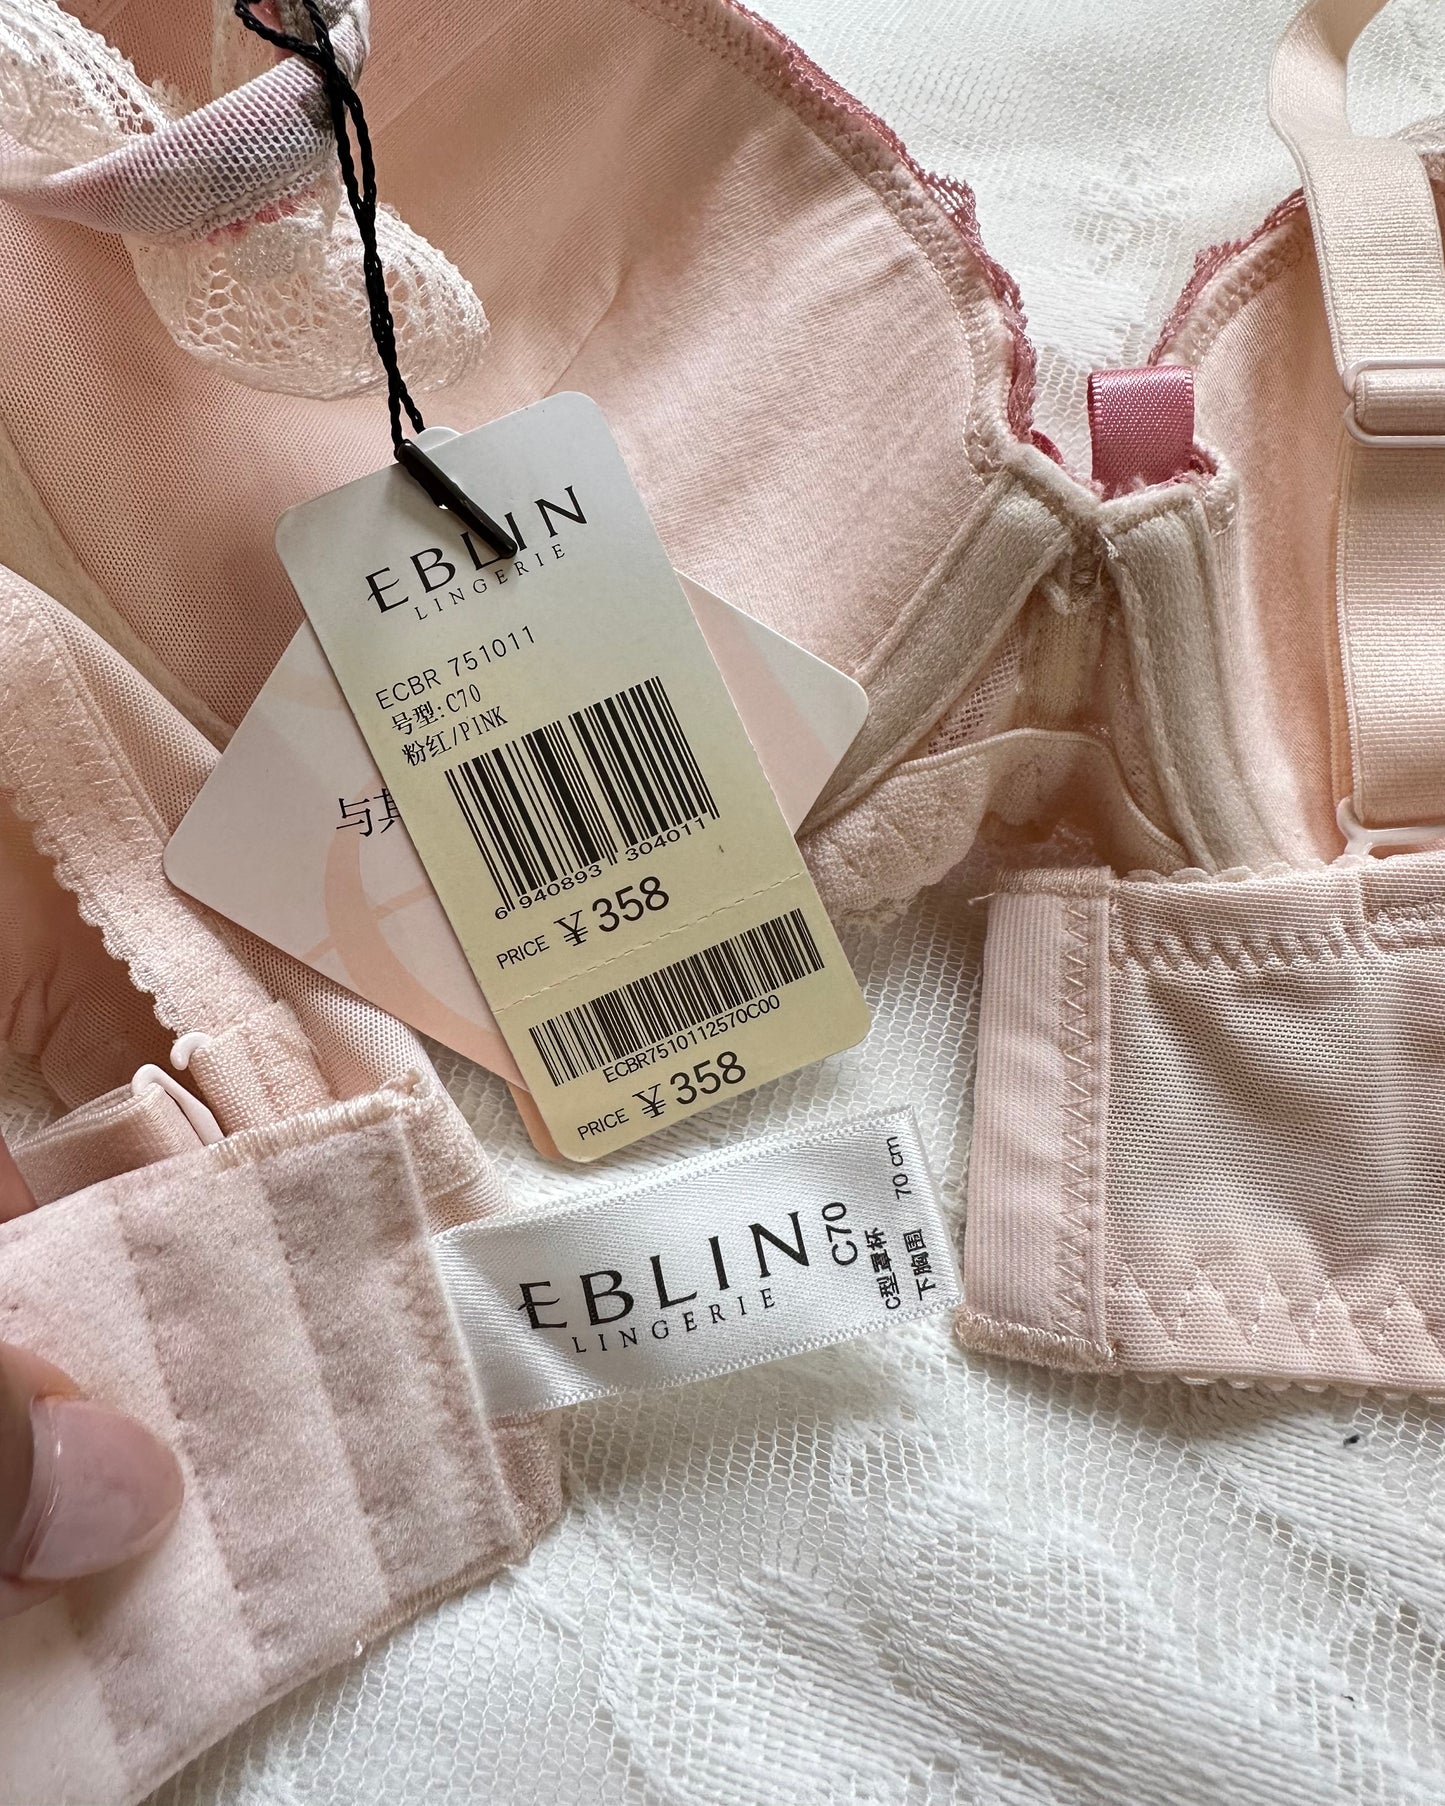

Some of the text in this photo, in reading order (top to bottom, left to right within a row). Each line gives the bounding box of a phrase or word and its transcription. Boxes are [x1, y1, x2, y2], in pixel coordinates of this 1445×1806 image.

[366, 485, 588, 613] EBLIN
[415, 543, 566, 620] LINGERIE
[375, 626, 536, 710] ECBR 751011
[402, 706, 508, 766] 粉红/PINK
[519, 864, 603, 909] 940893
[625, 818, 706, 862] 304011
[496, 935, 550, 970] PRICE
[602, 994, 780, 1084] ECBR7510112570C00
[577, 1107, 630, 1141] PRICE
[821, 1201, 859, 1266] C70
[886, 1136, 936, 1301] 下胸围 70 cm
[518, 1211, 811, 1329] EBLIN
[572, 1288, 775, 1354] LINGERIE
